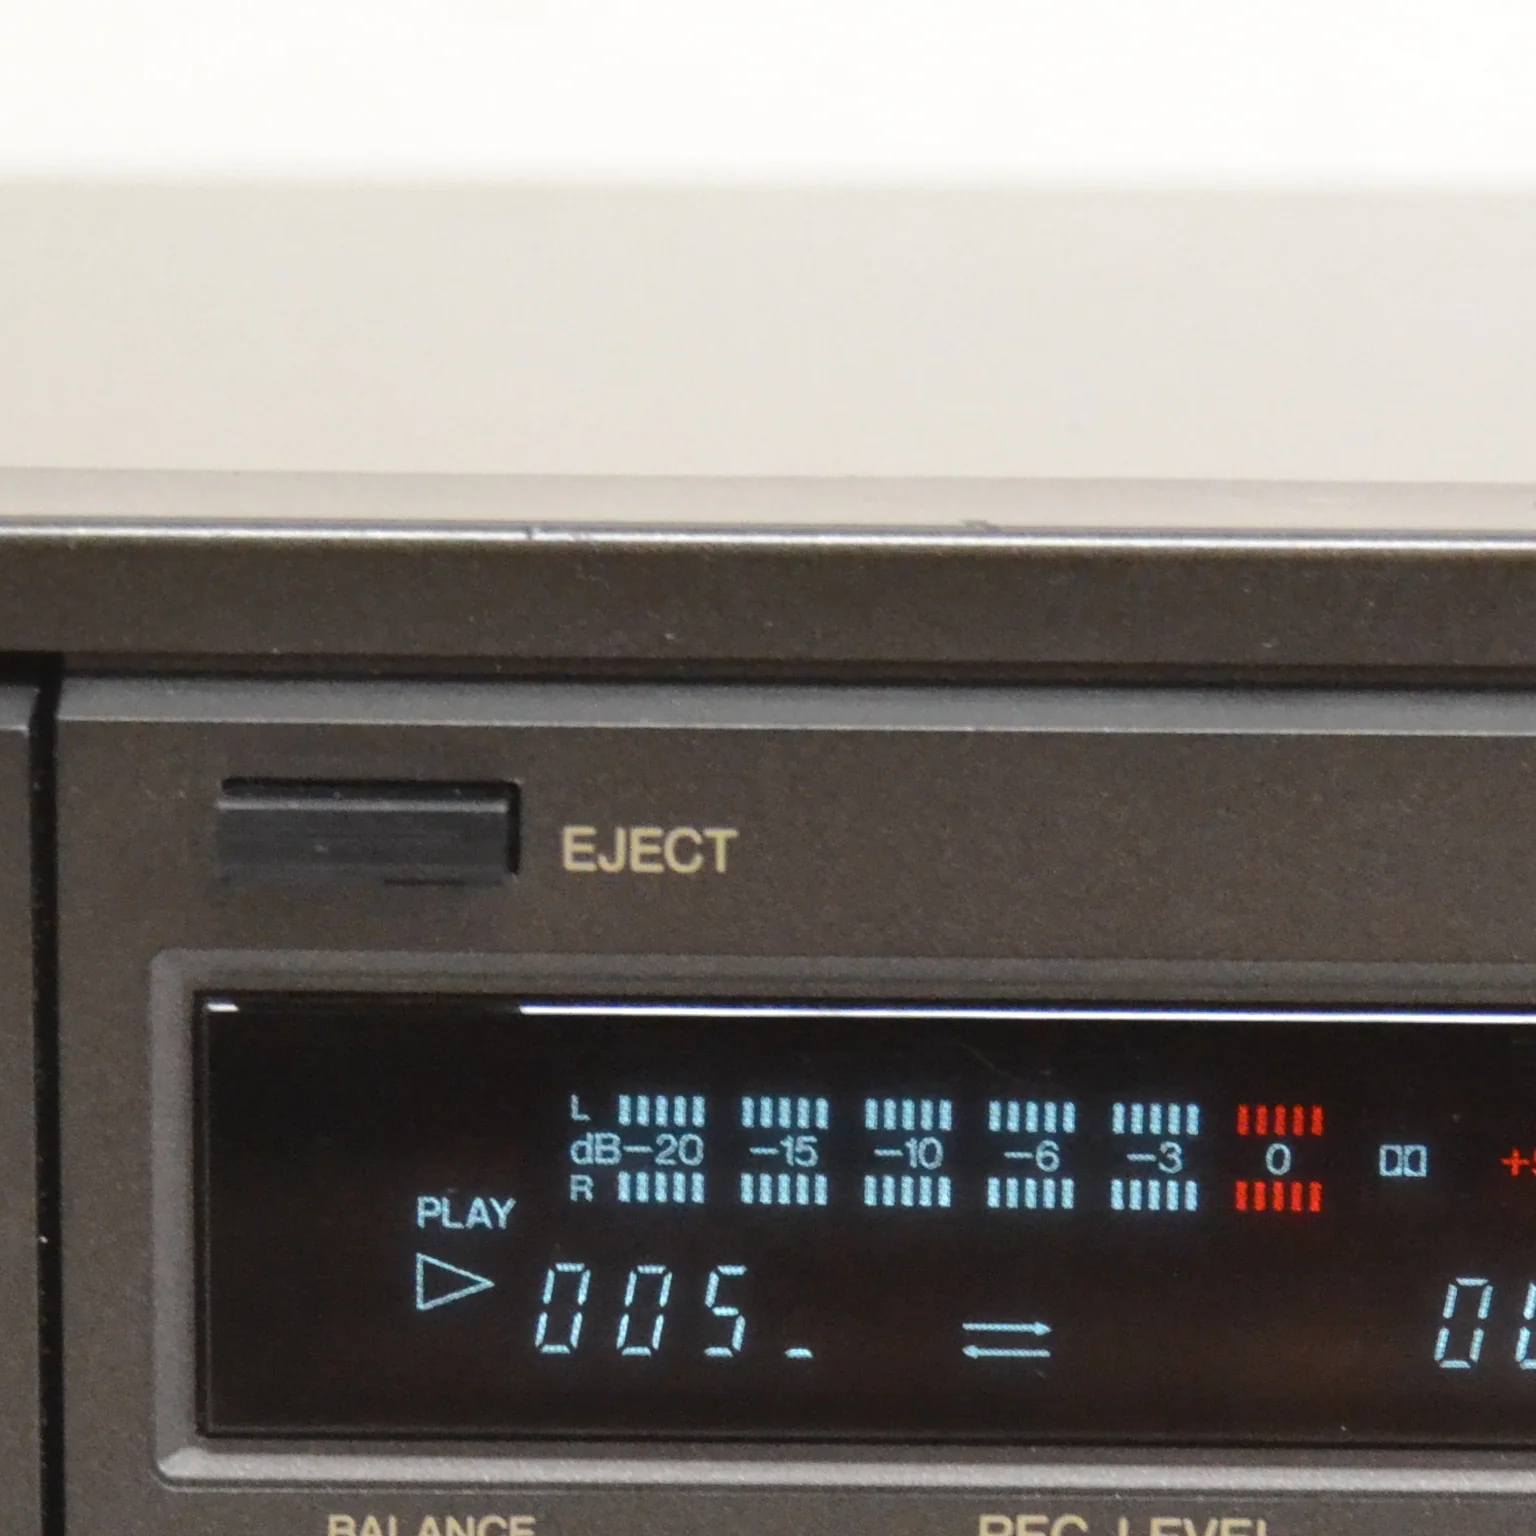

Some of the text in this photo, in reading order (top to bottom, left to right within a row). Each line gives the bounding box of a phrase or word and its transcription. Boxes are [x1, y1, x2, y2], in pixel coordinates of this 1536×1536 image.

[562, 825, 739, 874] EJECT
[570, 1094, 591, 1122] L
[750, 1134, 819, 1168] -15
[874, 1135, 944, 1171] -10
[1004, 1138, 1061, 1173] -6
[1127, 1140, 1183, 1175] -3
[1265, 1142, 1292, 1176] 0
[570, 1173, 594, 1201] R
[416, 1195, 515, 1229] PLAY
